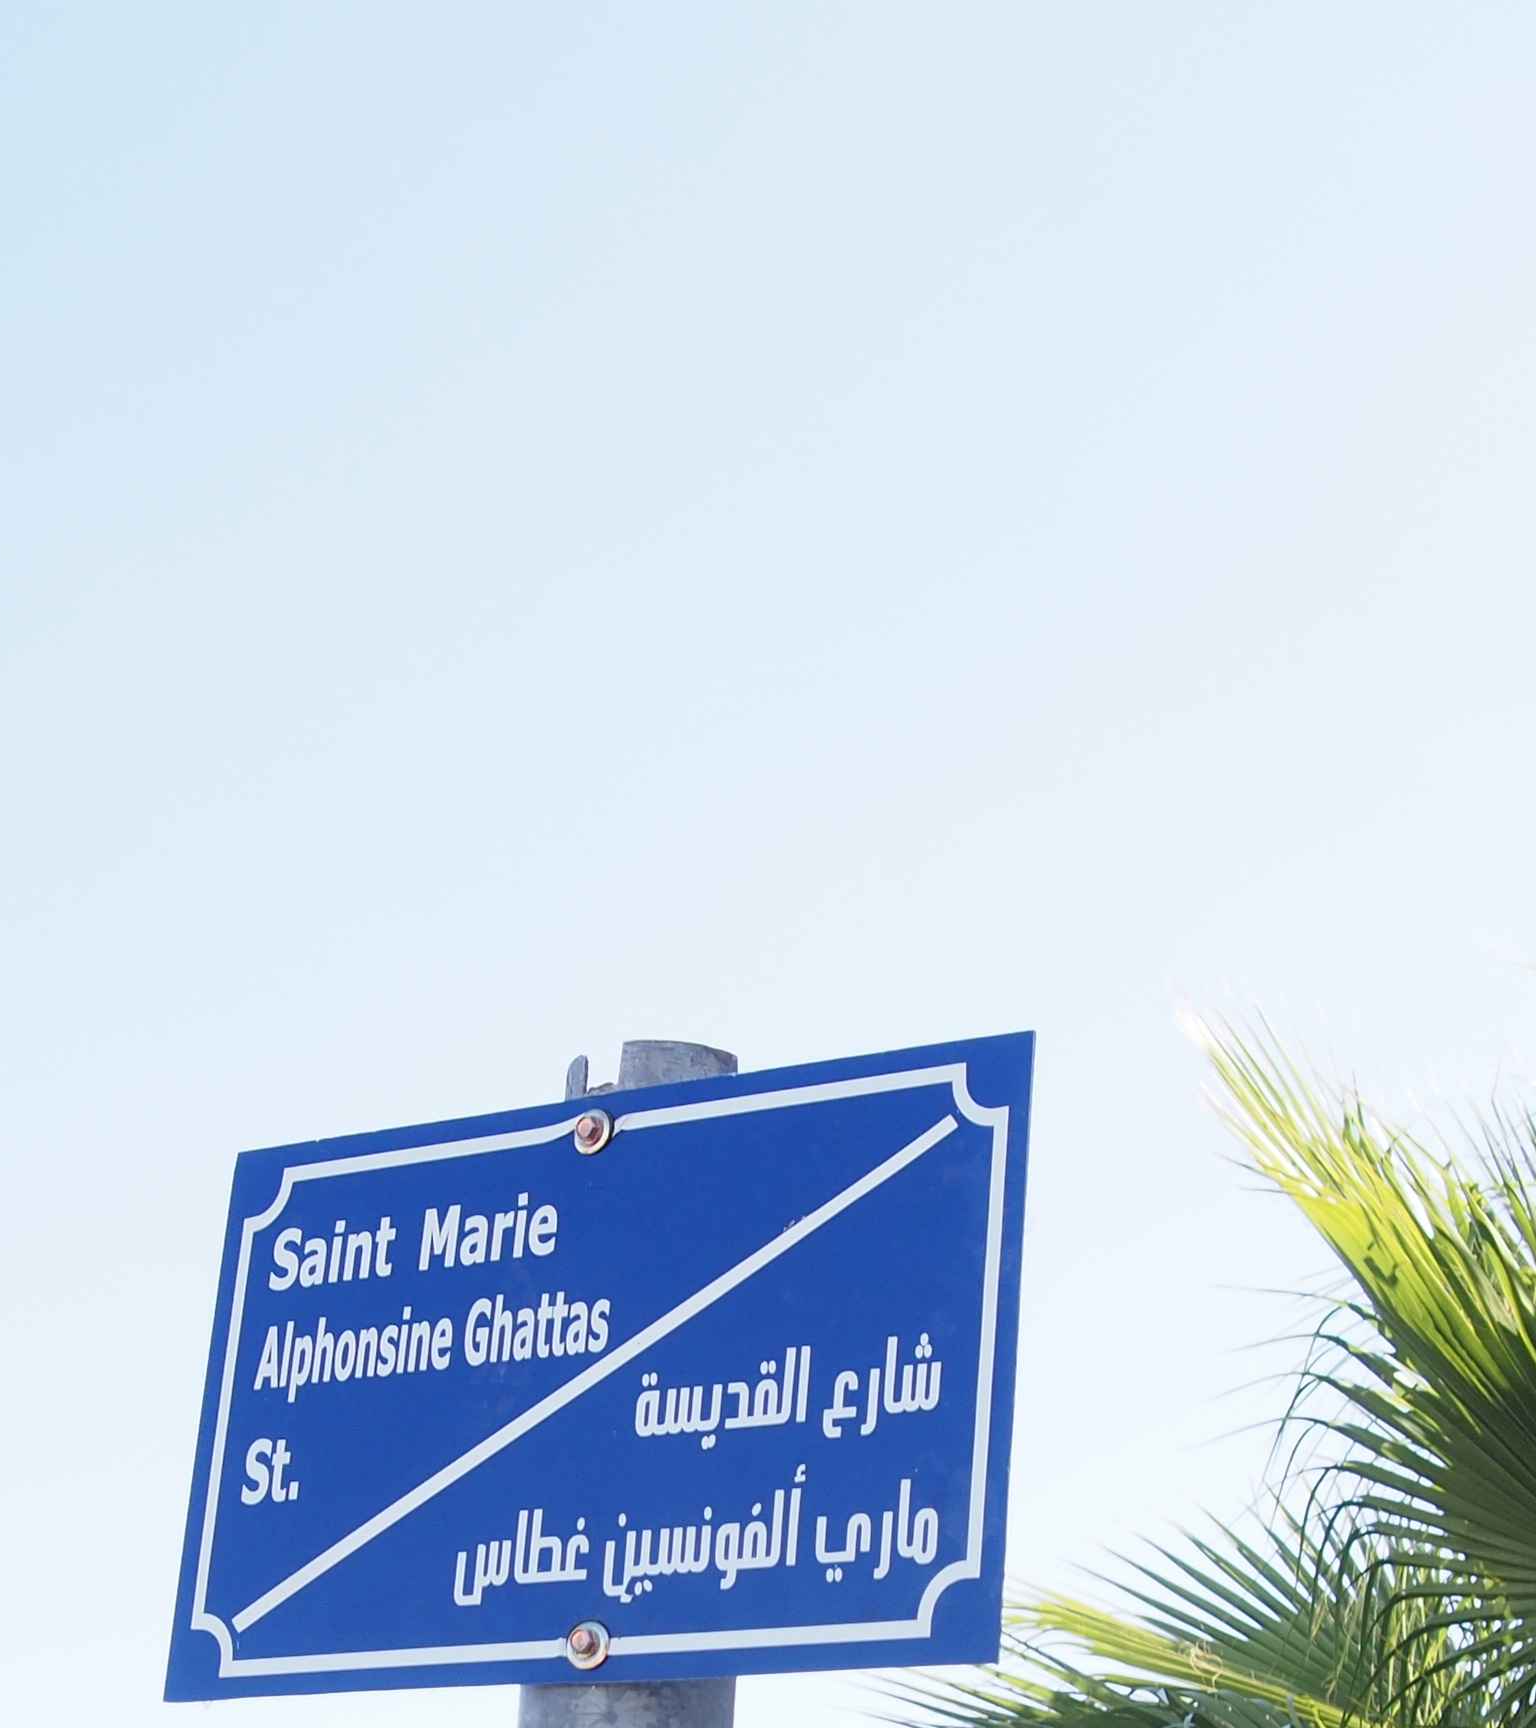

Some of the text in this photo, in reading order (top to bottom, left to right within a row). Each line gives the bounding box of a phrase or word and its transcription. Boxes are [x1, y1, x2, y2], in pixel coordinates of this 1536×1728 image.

[268, 1191, 558, 1291] Saint Marie
[254, 1291, 611, 1403] Alphonsine Ghattas
[634, 1331, 942, 1451] شارع القديسة
[240, 1438, 300, 1506] St.
[452, 1507, 591, 1608] غطاس
[813, 1477, 940, 1584] ماري
